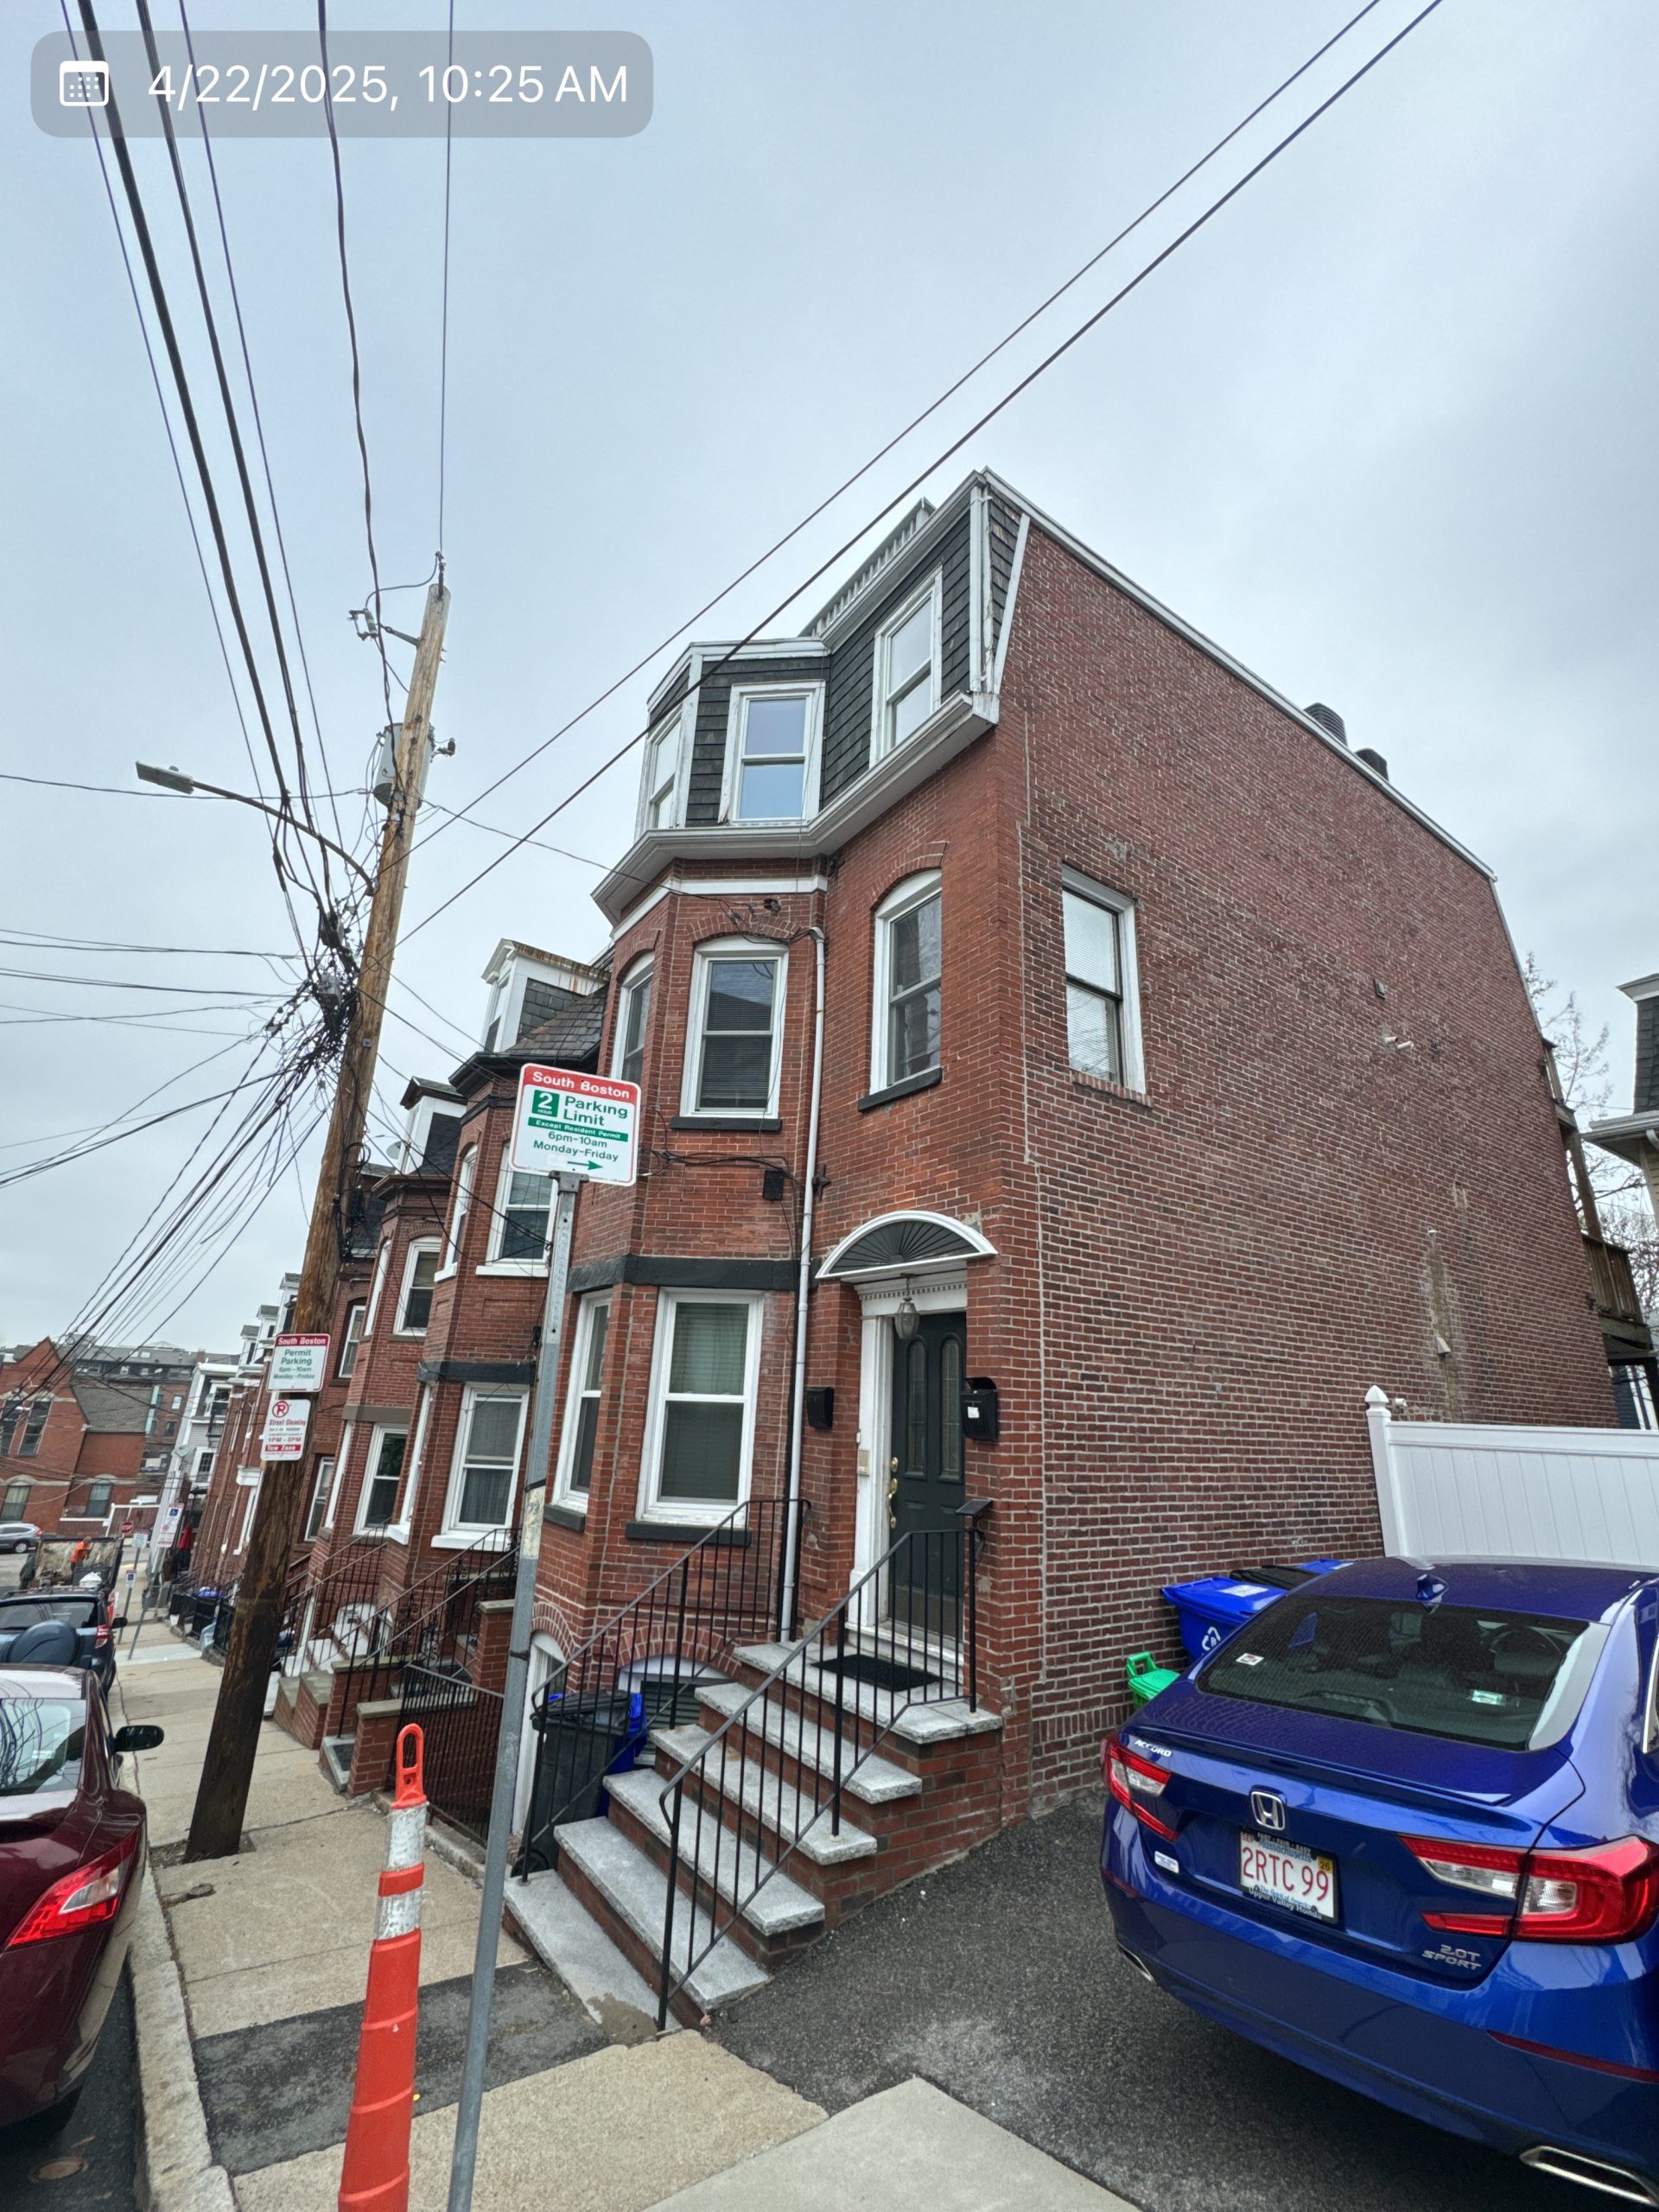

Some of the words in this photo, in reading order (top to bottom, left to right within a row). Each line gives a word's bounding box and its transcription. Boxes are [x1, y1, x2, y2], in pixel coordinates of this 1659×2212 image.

[532, 1071, 575, 1089] South
[580, 1080, 630, 1099] Boston
[537, 1092, 553, 1109] 2
[564, 1096, 628, 1119] Parking
[563, 1109, 605, 1126] Limit
[536, 1119, 562, 1129] Except
[564, 1124, 596, 1135] Resident
[598, 1130, 621, 1140] Permit
[548, 1130, 607, 1148] 6pm-10am
[533, 1140, 619, 1162] Monday-Friday
[277, 1337, 298, 1345] South
[300, 1337, 327, 1345] Boston
[281, 1357, 312, 1366] Parking
[1134, 1739, 1173, 1758] ACCORD
[1258, 1838, 1313, 1863] Massachusetts
[1243, 1847, 1294, 1891] 2RTC
[1301, 1865, 1330, 1901] 99
[1319, 1860, 1331, 1872] 26
[1249, 1886, 1271, 1900] Upper
[1272, 1897, 1294, 1910] Valley
[1296, 1904, 1322, 1919] Honda
[1421, 1950, 1482, 1970] SPORT
